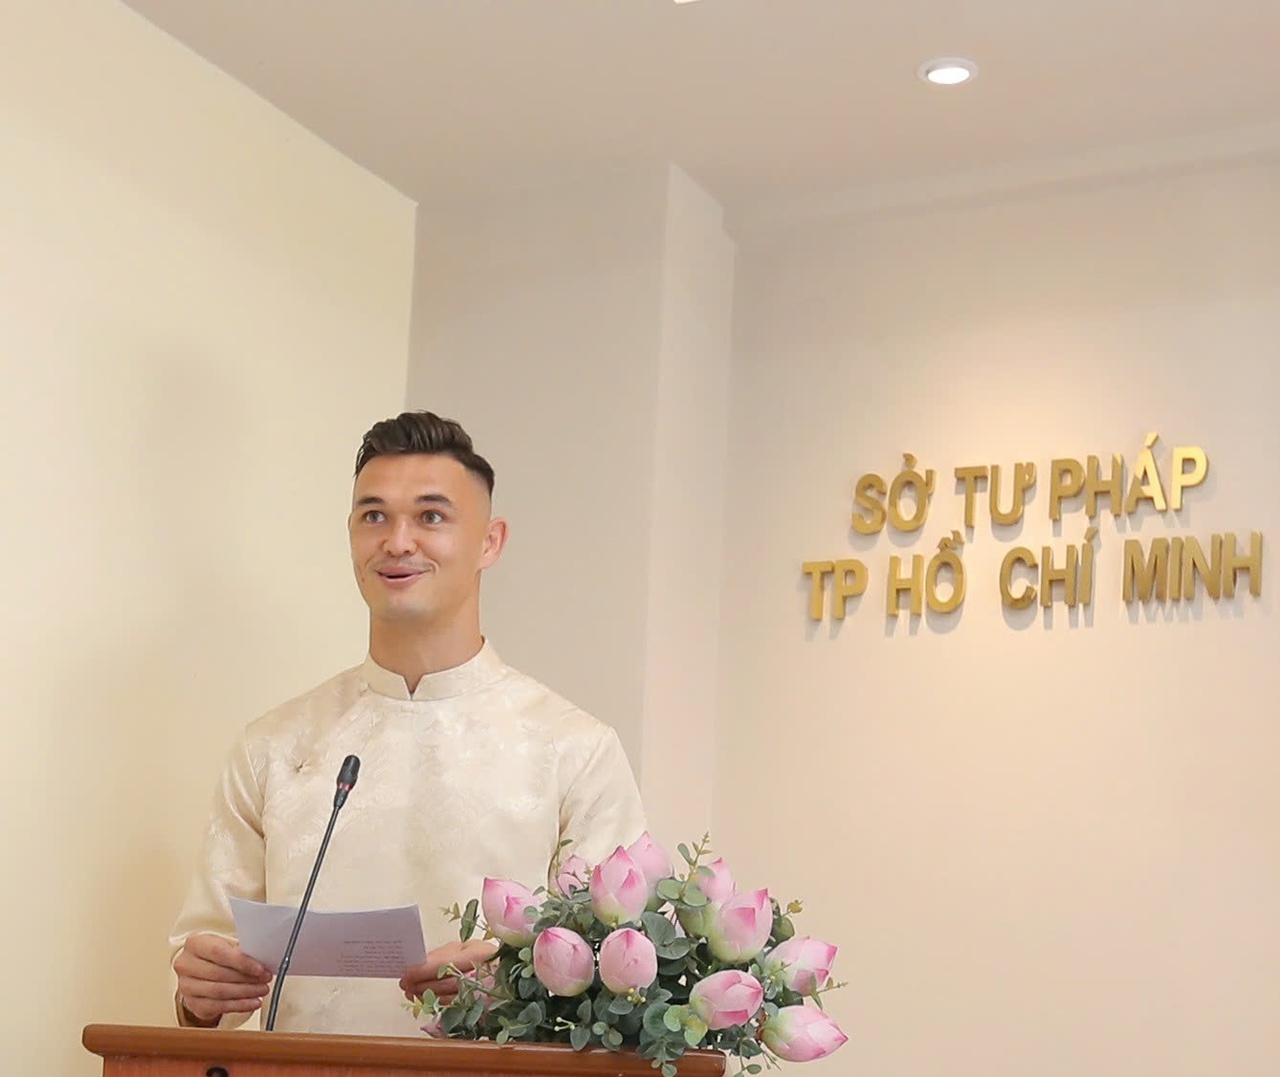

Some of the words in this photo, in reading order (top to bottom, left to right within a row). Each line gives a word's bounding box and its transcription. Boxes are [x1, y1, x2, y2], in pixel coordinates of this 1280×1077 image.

[852, 452, 936, 536] SỞ
[954, 461, 1037, 528] TƯ
[1048, 431, 1209, 521] PHÁP
[802, 558, 868, 622] TP
[886, 530, 967, 617] HỒ
[999, 526, 1099, 610] CHÍ
[1122, 531, 1263, 603] MINH
